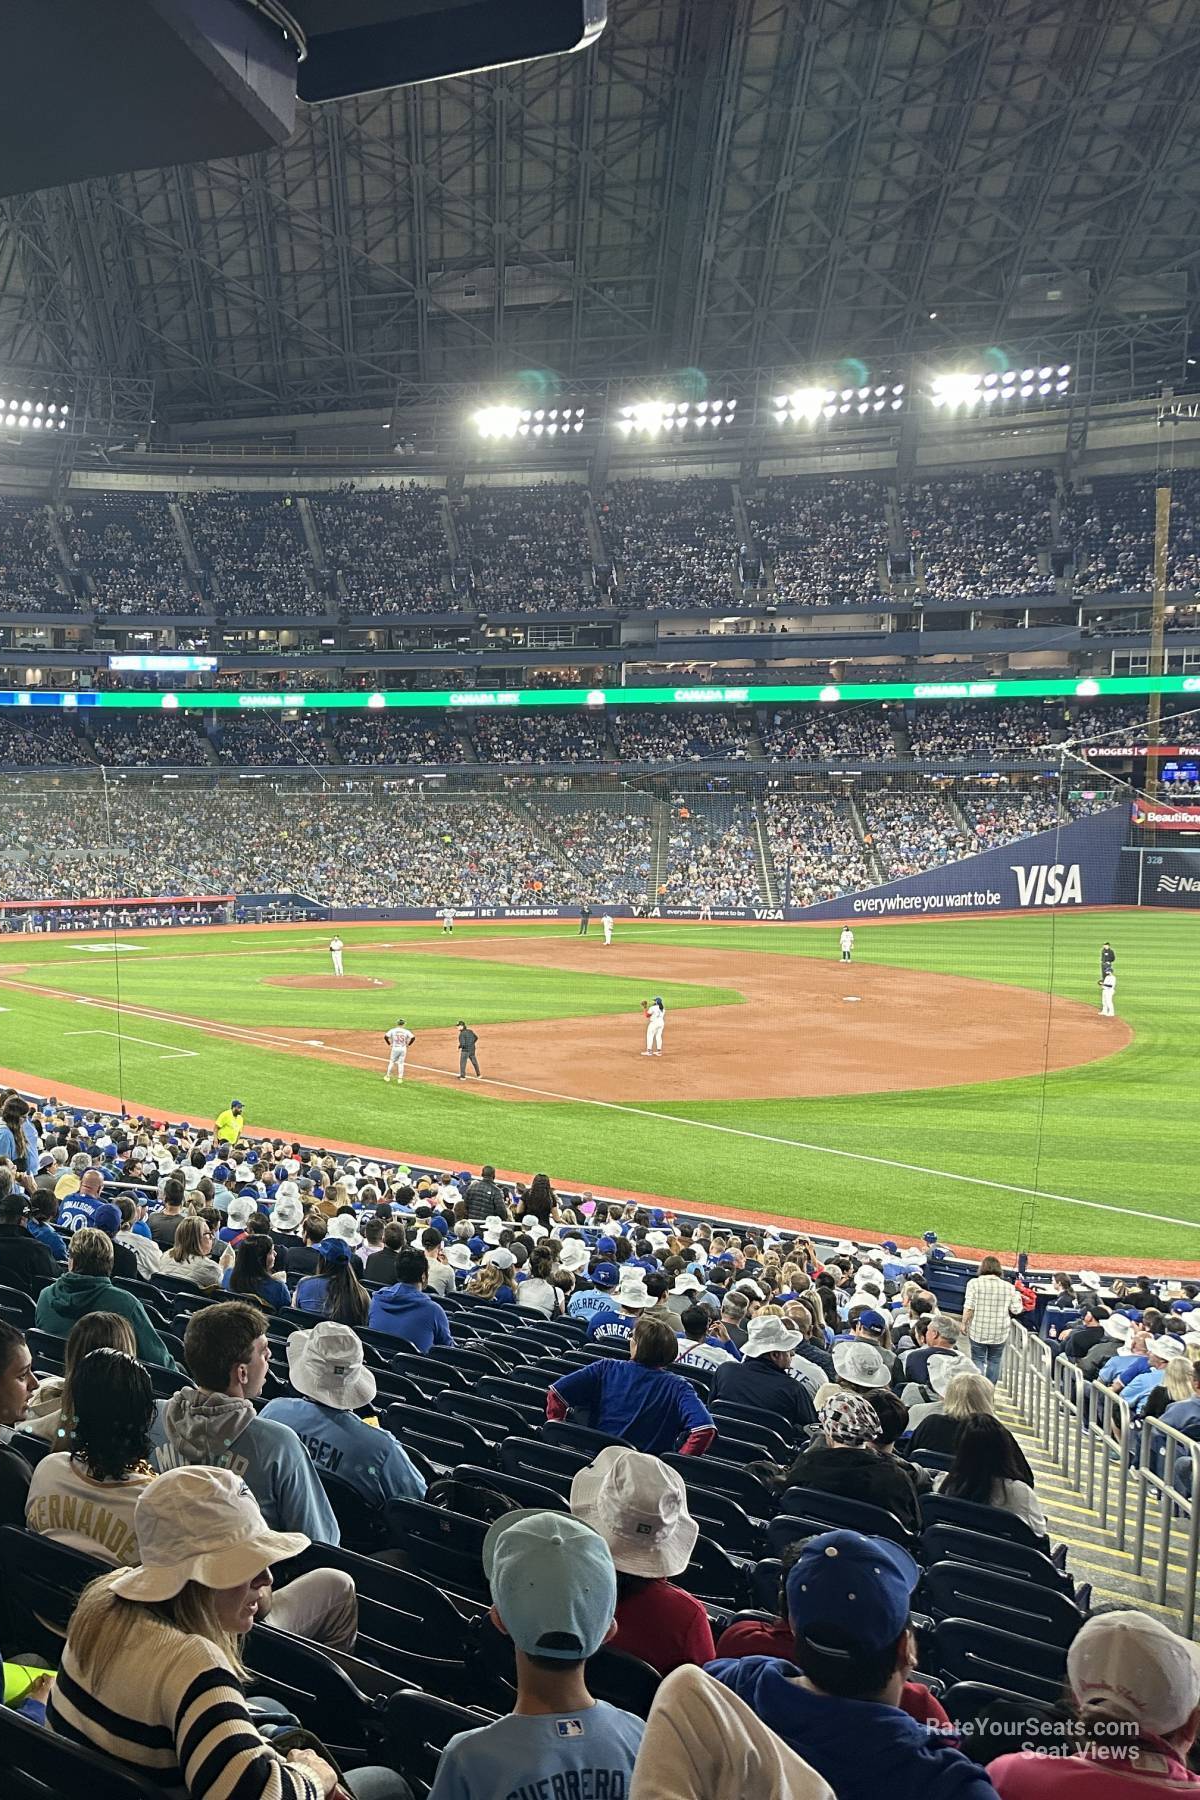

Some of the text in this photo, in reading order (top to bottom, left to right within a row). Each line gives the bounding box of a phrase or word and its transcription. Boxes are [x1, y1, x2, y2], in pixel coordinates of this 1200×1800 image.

[1098, 747, 1133, 755] ROGERS
[1146, 856, 1163, 864] 328
[1010, 864, 1083, 906] VISA
[853, 889, 1000, 914] everywhere you want to be
[481, 909, 497, 917] BET
[543, 908, 559, 916] BOX
[632, 906, 661, 917] VA
[753, 908, 784, 920] VISA
[61, 1211, 88, 1233] 20
[27, 1494, 139, 1563] HERNANDE
